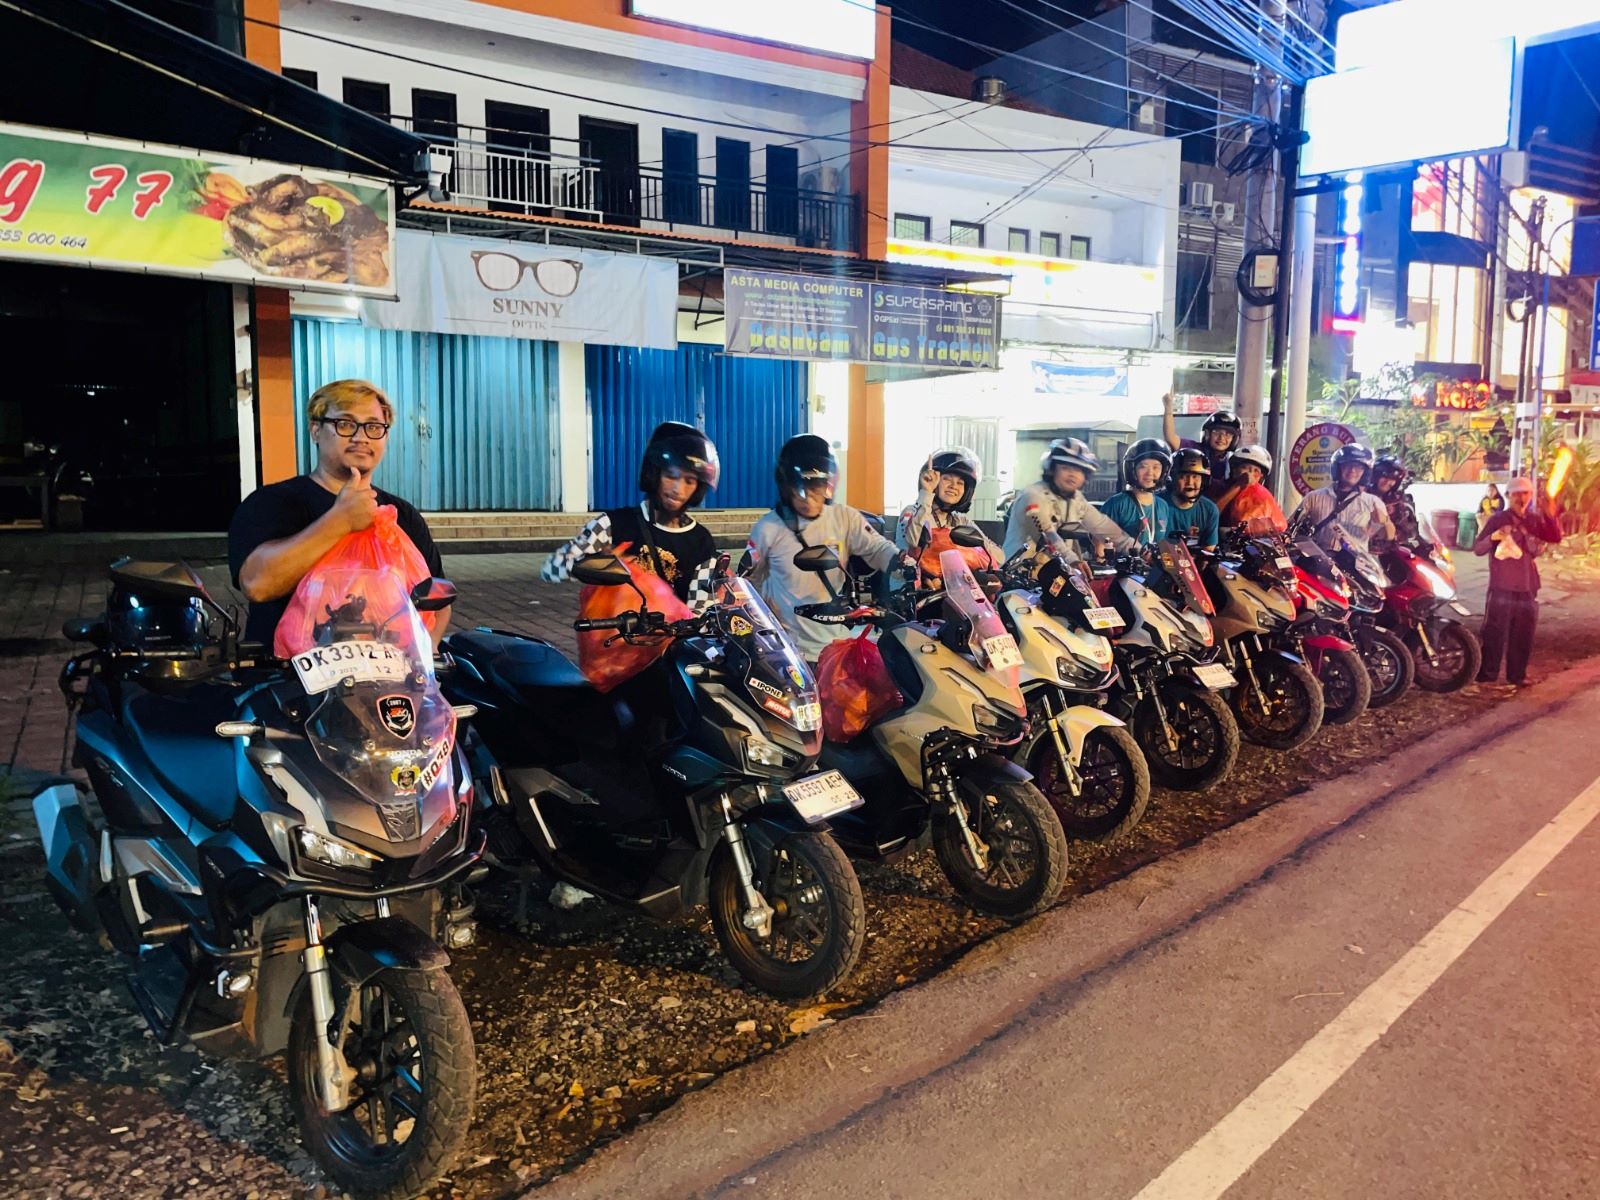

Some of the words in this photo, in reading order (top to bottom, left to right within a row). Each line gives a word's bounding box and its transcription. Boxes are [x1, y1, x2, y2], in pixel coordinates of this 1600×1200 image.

[28, 232, 55, 246] 000
[730, 275, 761, 288] ASTA
[764, 278, 800, 291] MEDIA
[803, 282, 864, 298] COMPUTER
[492, 297, 564, 319] SUNNY
[885, 294, 973, 313] SUPERSPRING
[511, 319, 547, 330] OPTIK
[1291, 426, 1329, 464] TERANG
[756, 681, 782, 699] IPONE
